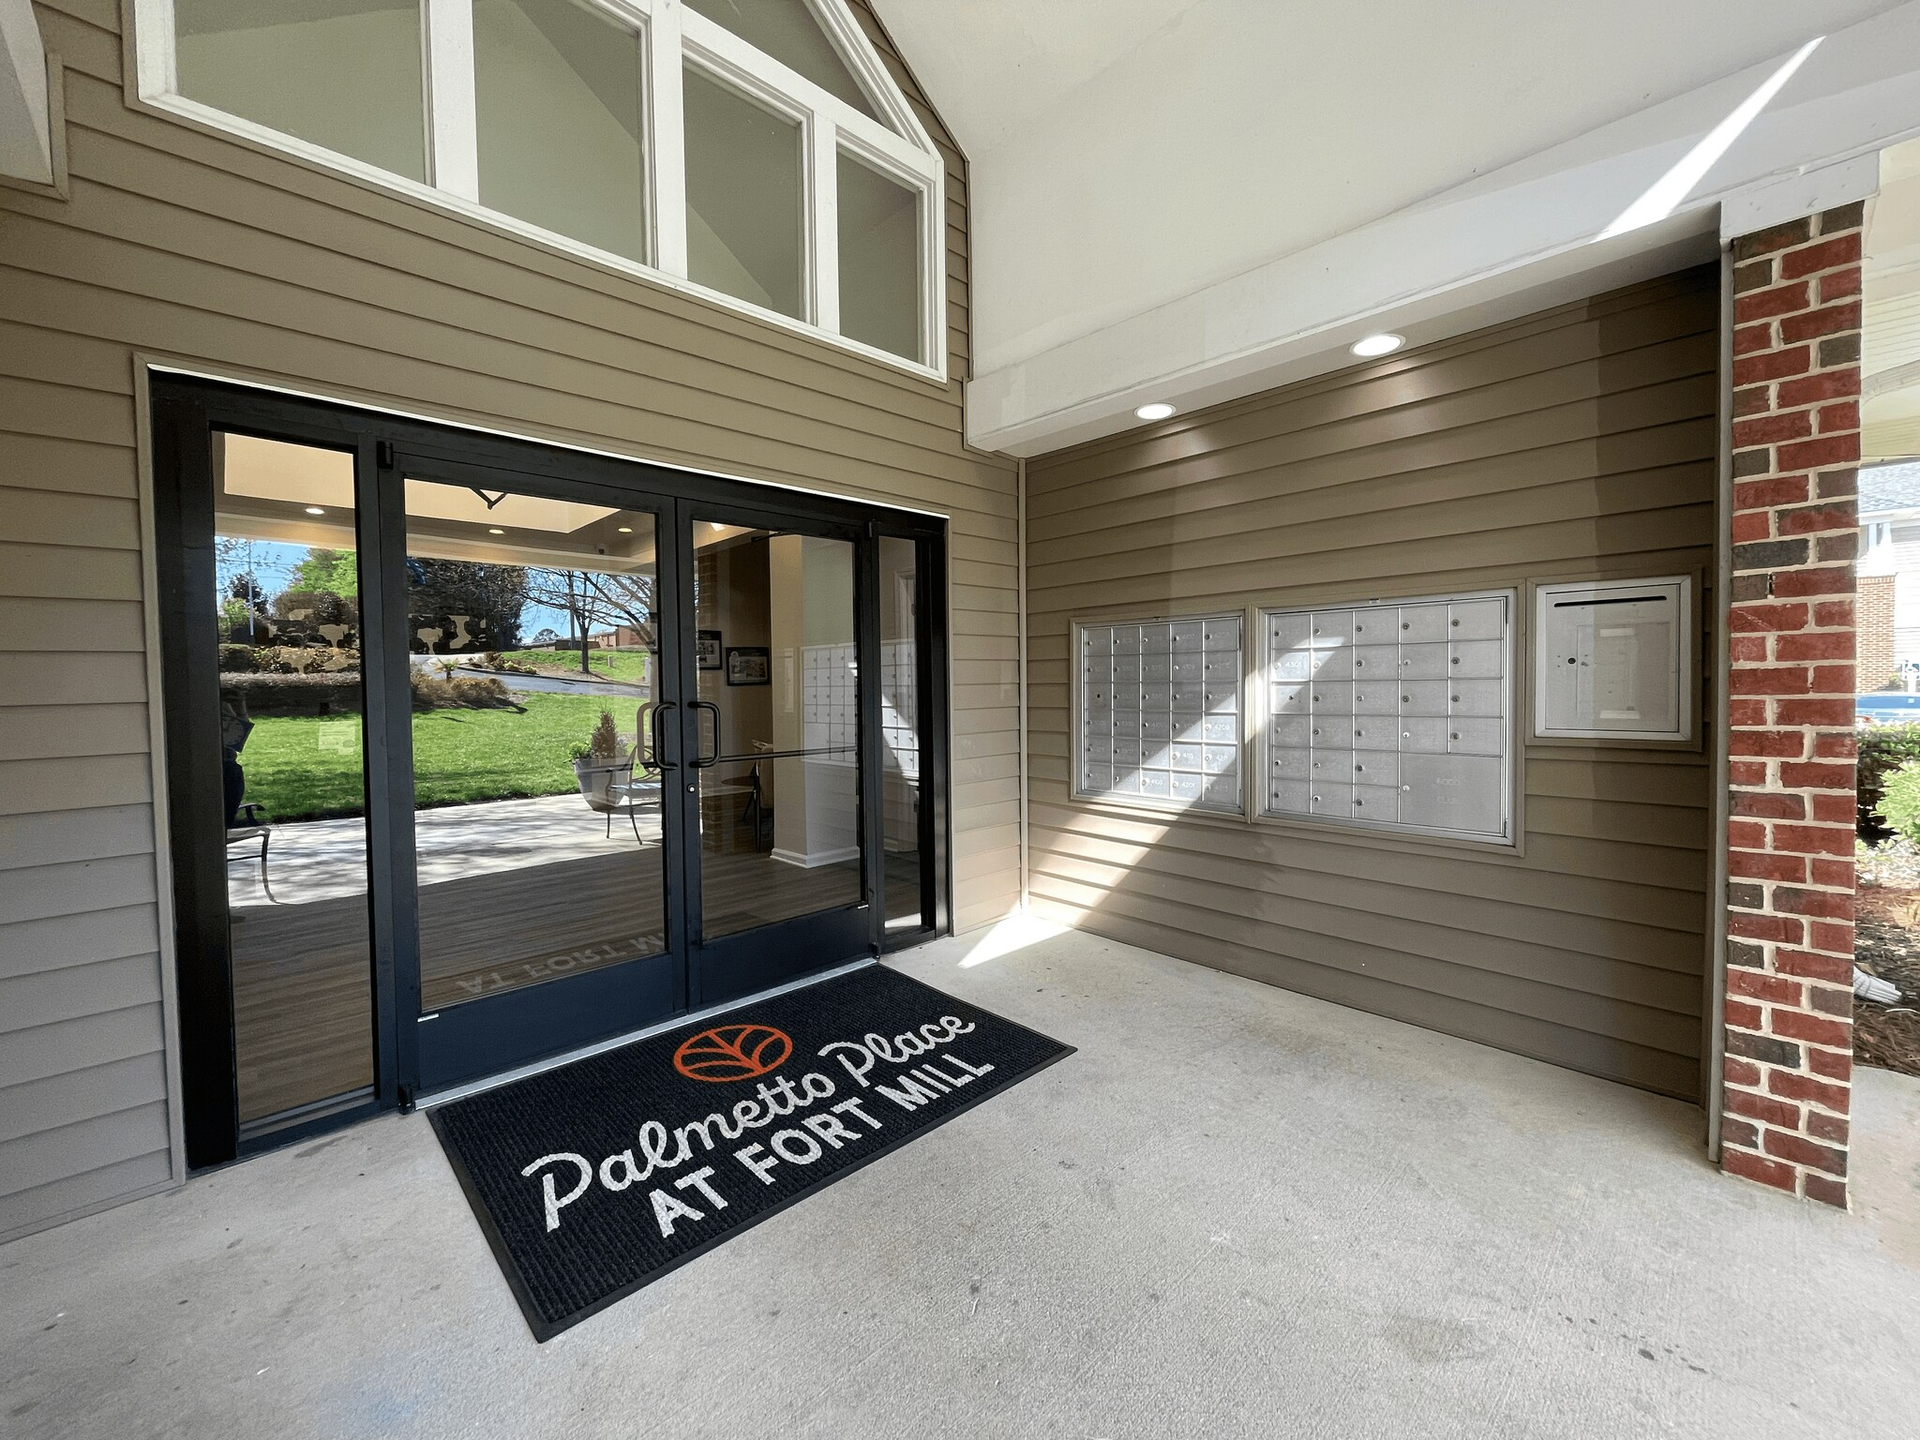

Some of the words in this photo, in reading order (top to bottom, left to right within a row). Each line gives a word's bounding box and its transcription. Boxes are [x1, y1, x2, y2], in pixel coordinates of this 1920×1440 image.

[521, 1072, 837, 1233] Palmetto
[817, 1013, 977, 1087] Place
[647, 1166, 730, 1238] AT
[733, 1096, 884, 1186] FORT
[877, 1052, 996, 1112] MILL
